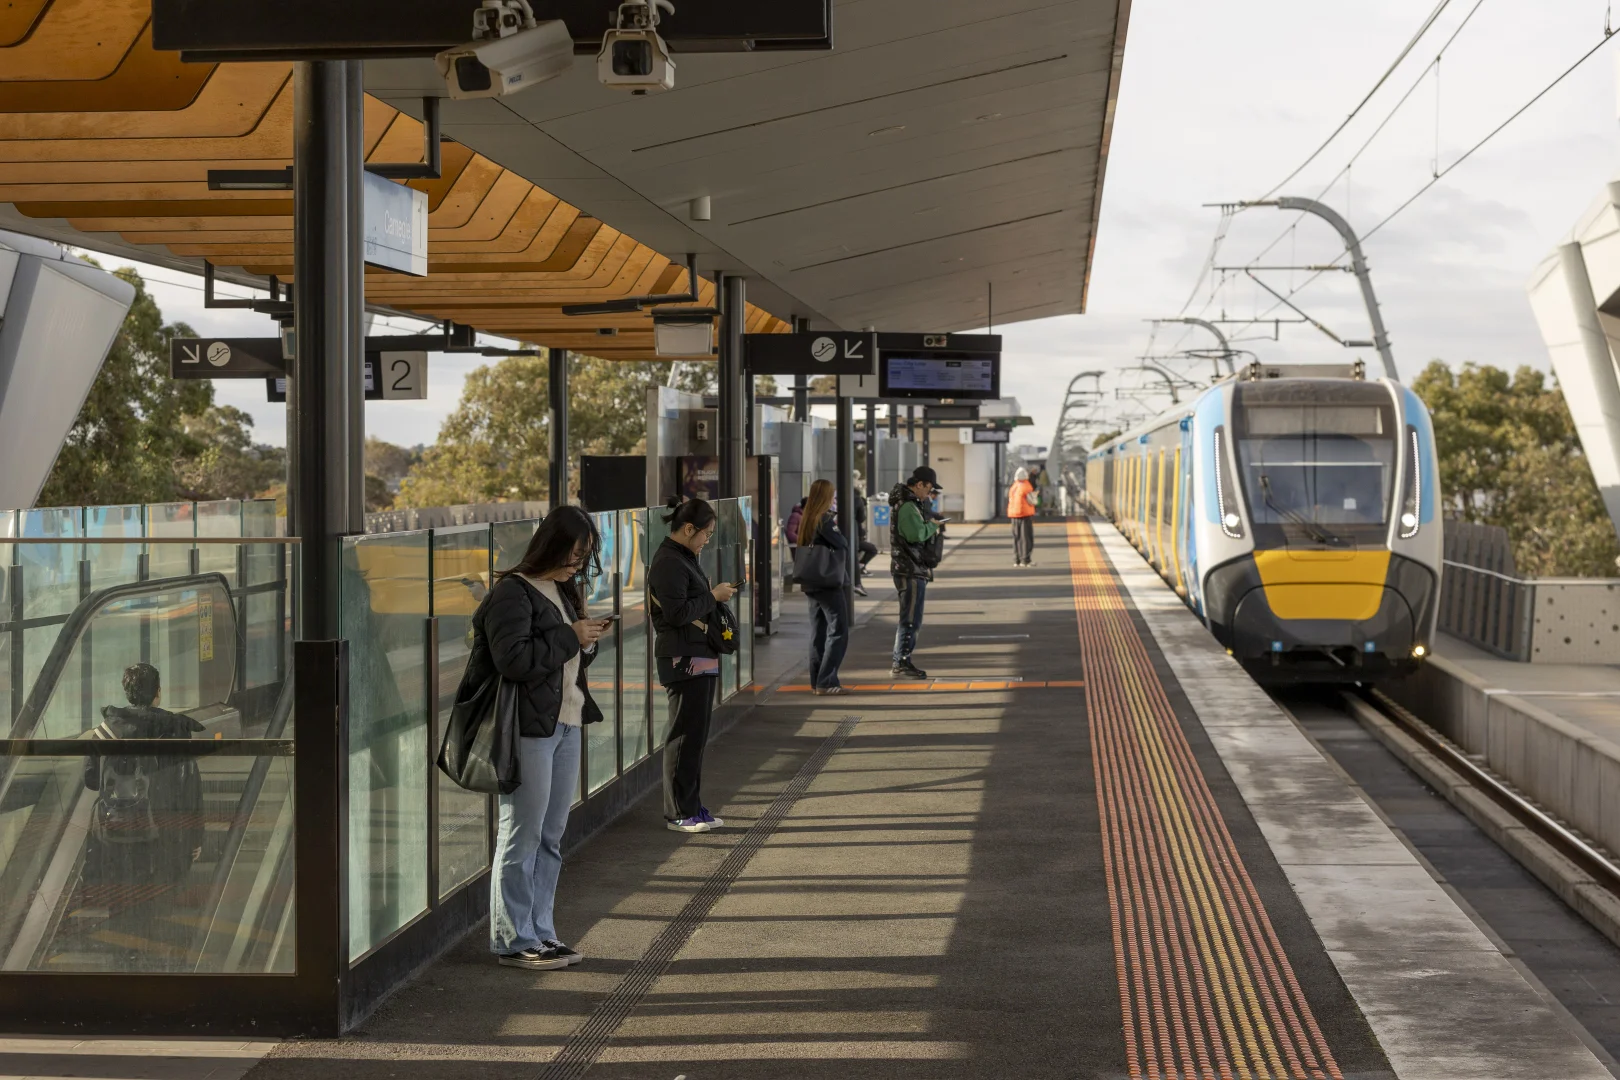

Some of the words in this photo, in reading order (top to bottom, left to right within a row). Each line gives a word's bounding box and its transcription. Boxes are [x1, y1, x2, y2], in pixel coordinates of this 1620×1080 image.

[384, 209, 411, 245] Carnegie
[417, 200, 423, 249] 1
[391, 359, 412, 391] 2
